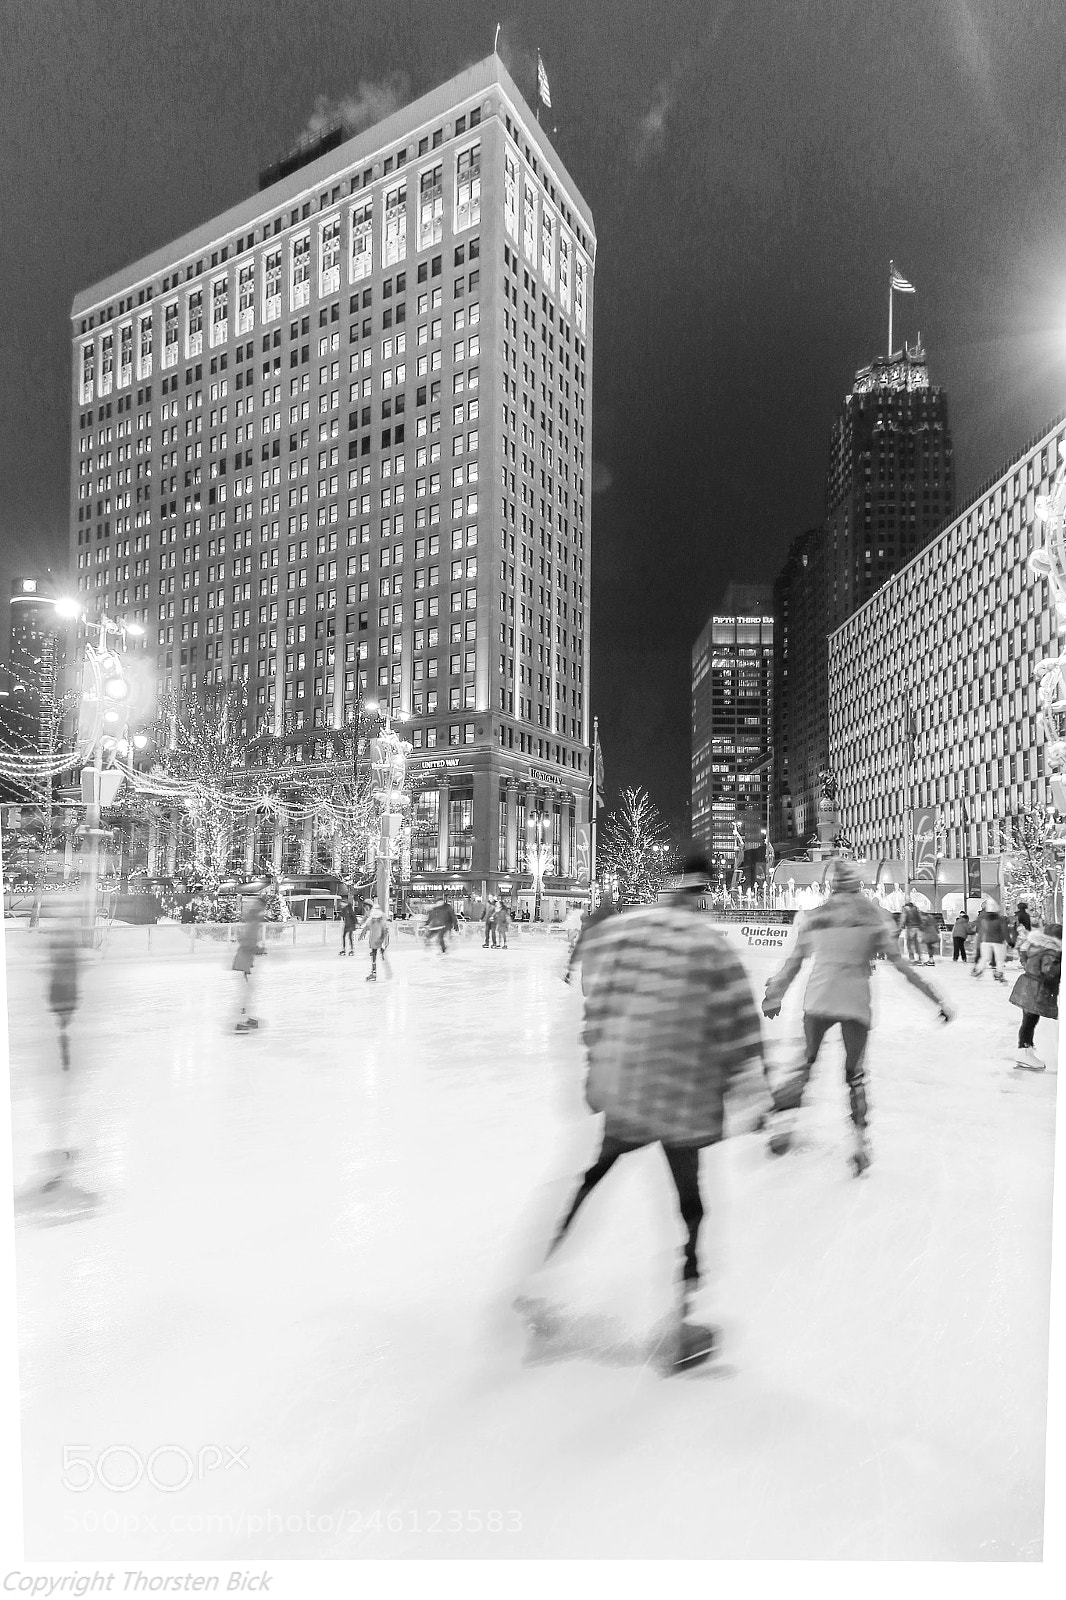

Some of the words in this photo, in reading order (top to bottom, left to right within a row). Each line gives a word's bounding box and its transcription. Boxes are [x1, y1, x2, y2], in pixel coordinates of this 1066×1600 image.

[712, 616, 735, 624] FIFTH
[736, 616, 761, 624] THIRD
[421, 760, 444, 769] UNITED
[446, 758, 460, 767] WAY
[741, 927, 788, 938] Quicken
[748, 937, 783, 947] Loans
